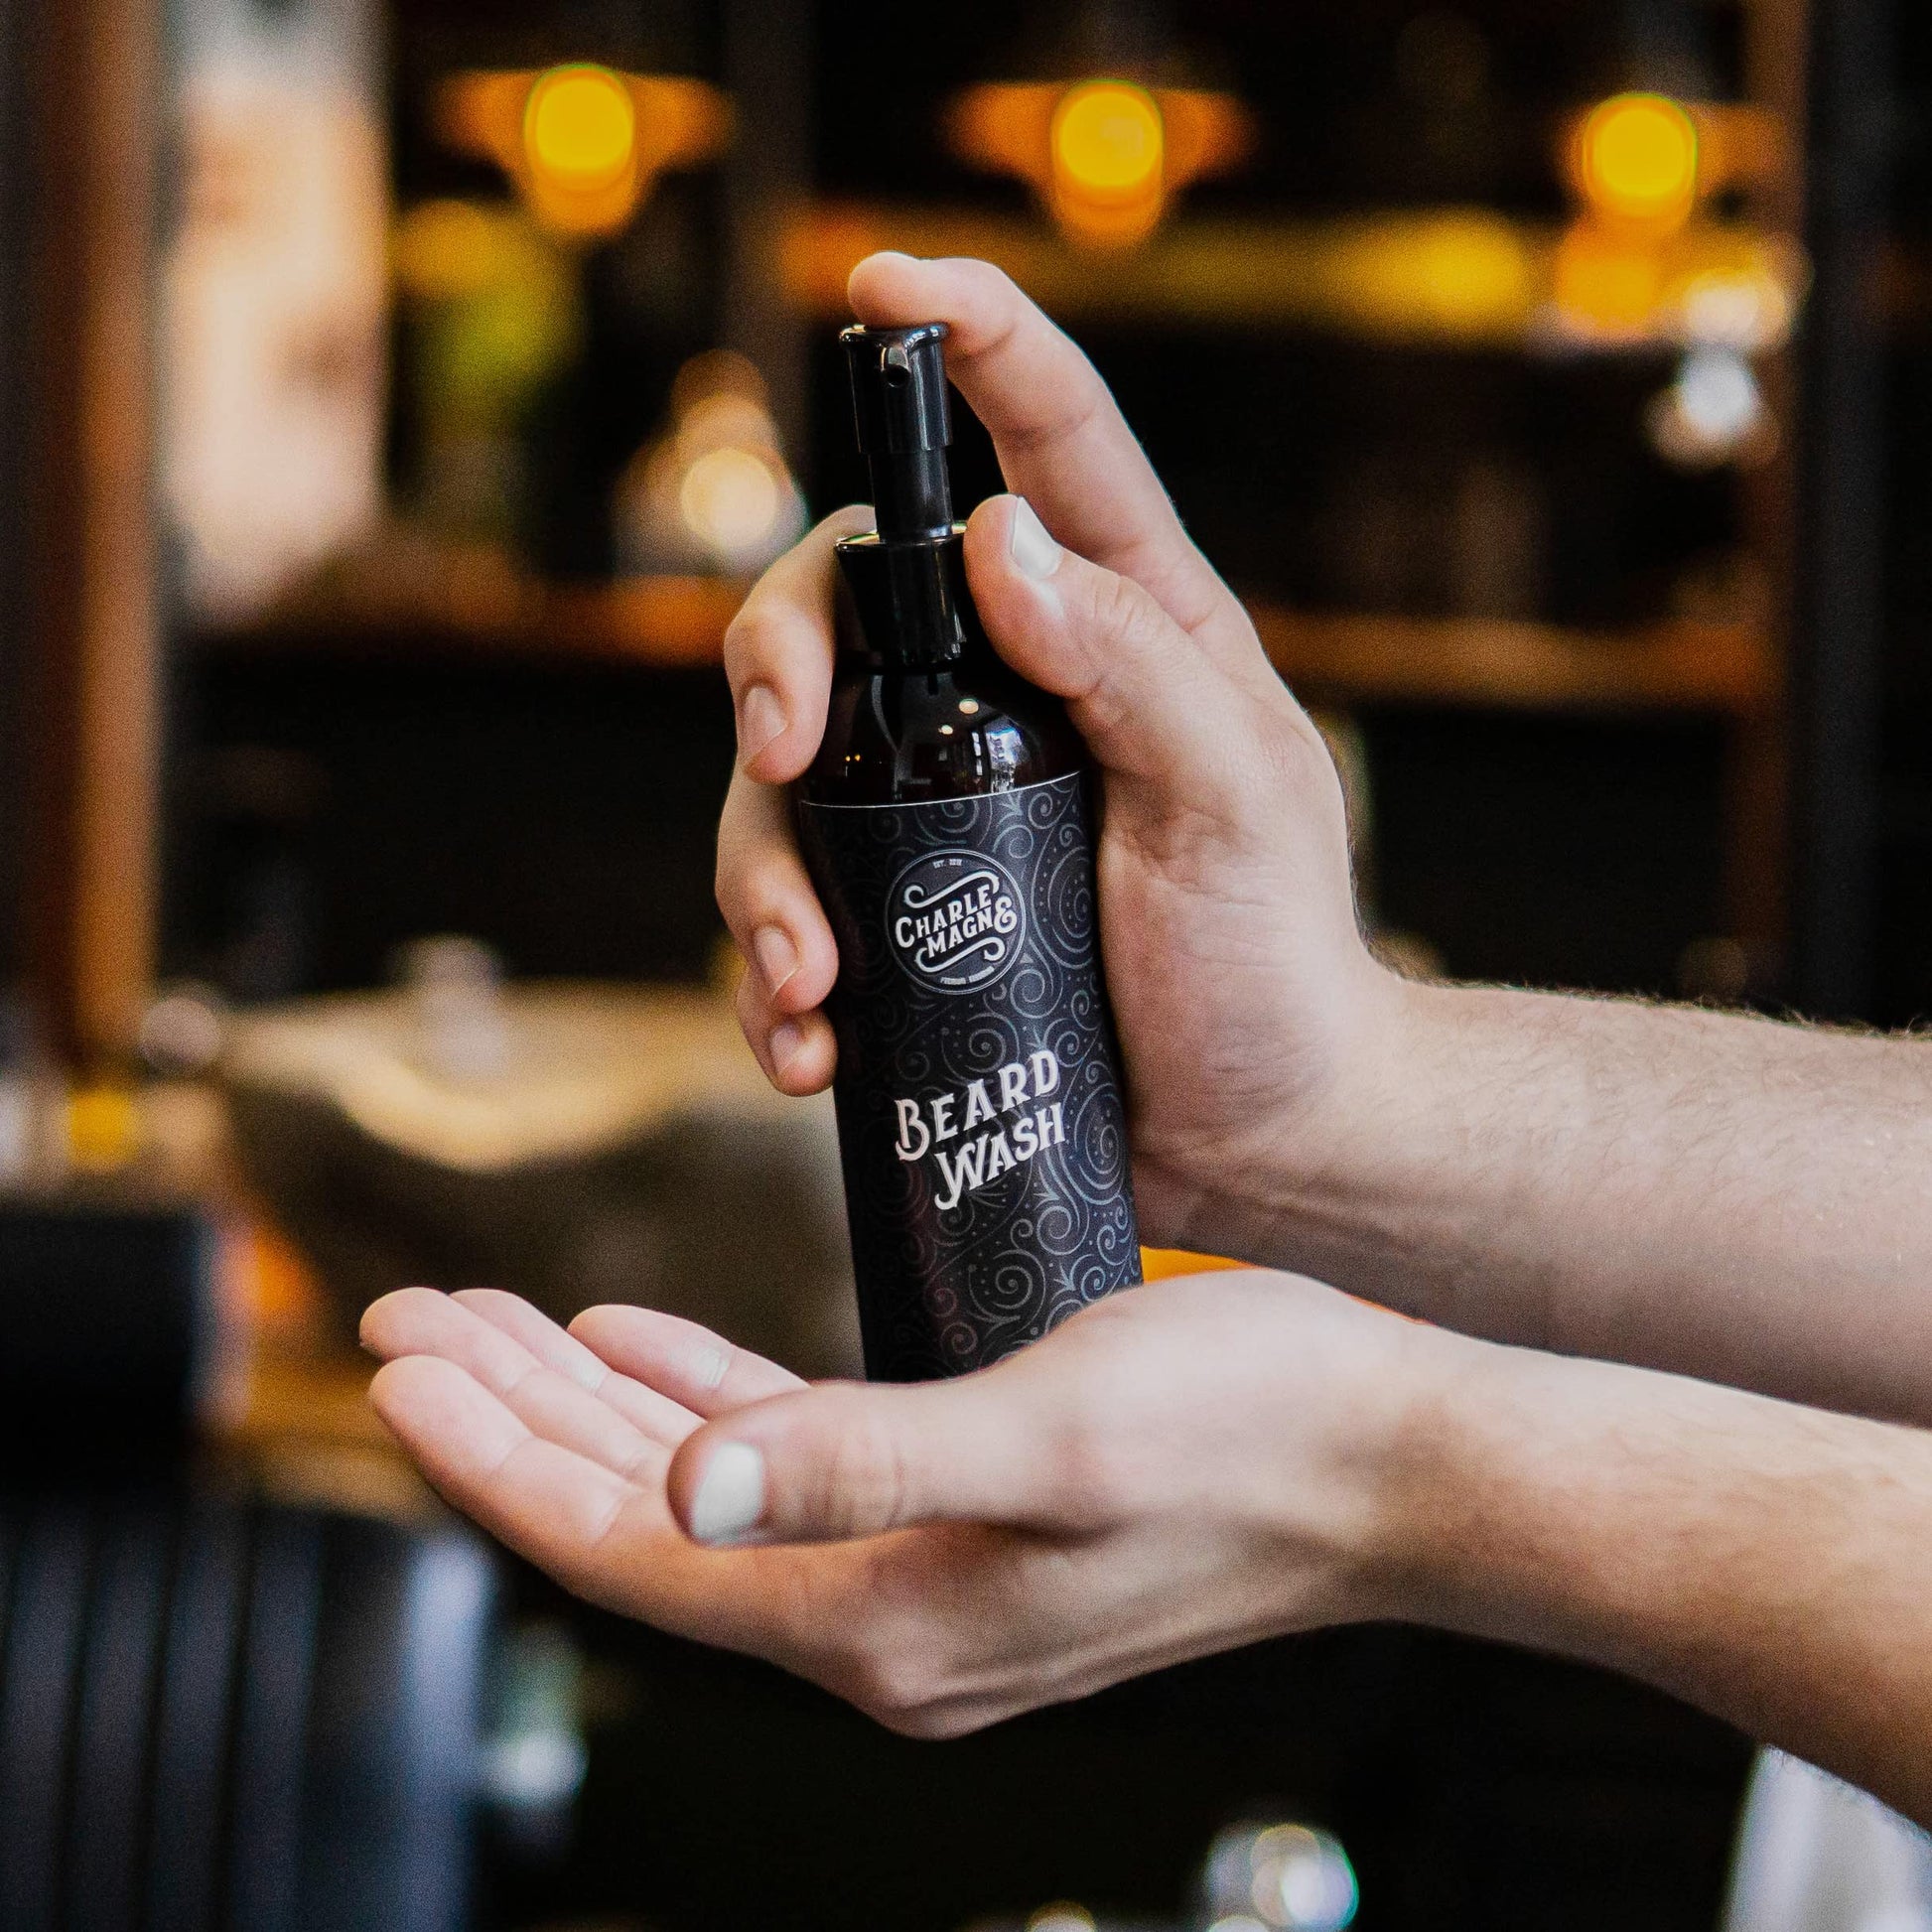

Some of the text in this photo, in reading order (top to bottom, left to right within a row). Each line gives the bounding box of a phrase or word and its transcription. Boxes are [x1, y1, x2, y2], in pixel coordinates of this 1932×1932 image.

[895, 884, 992, 948] CHARLE
[895, 1049, 1059, 1162] BEARD
[933, 1102, 1066, 1210] WASH
